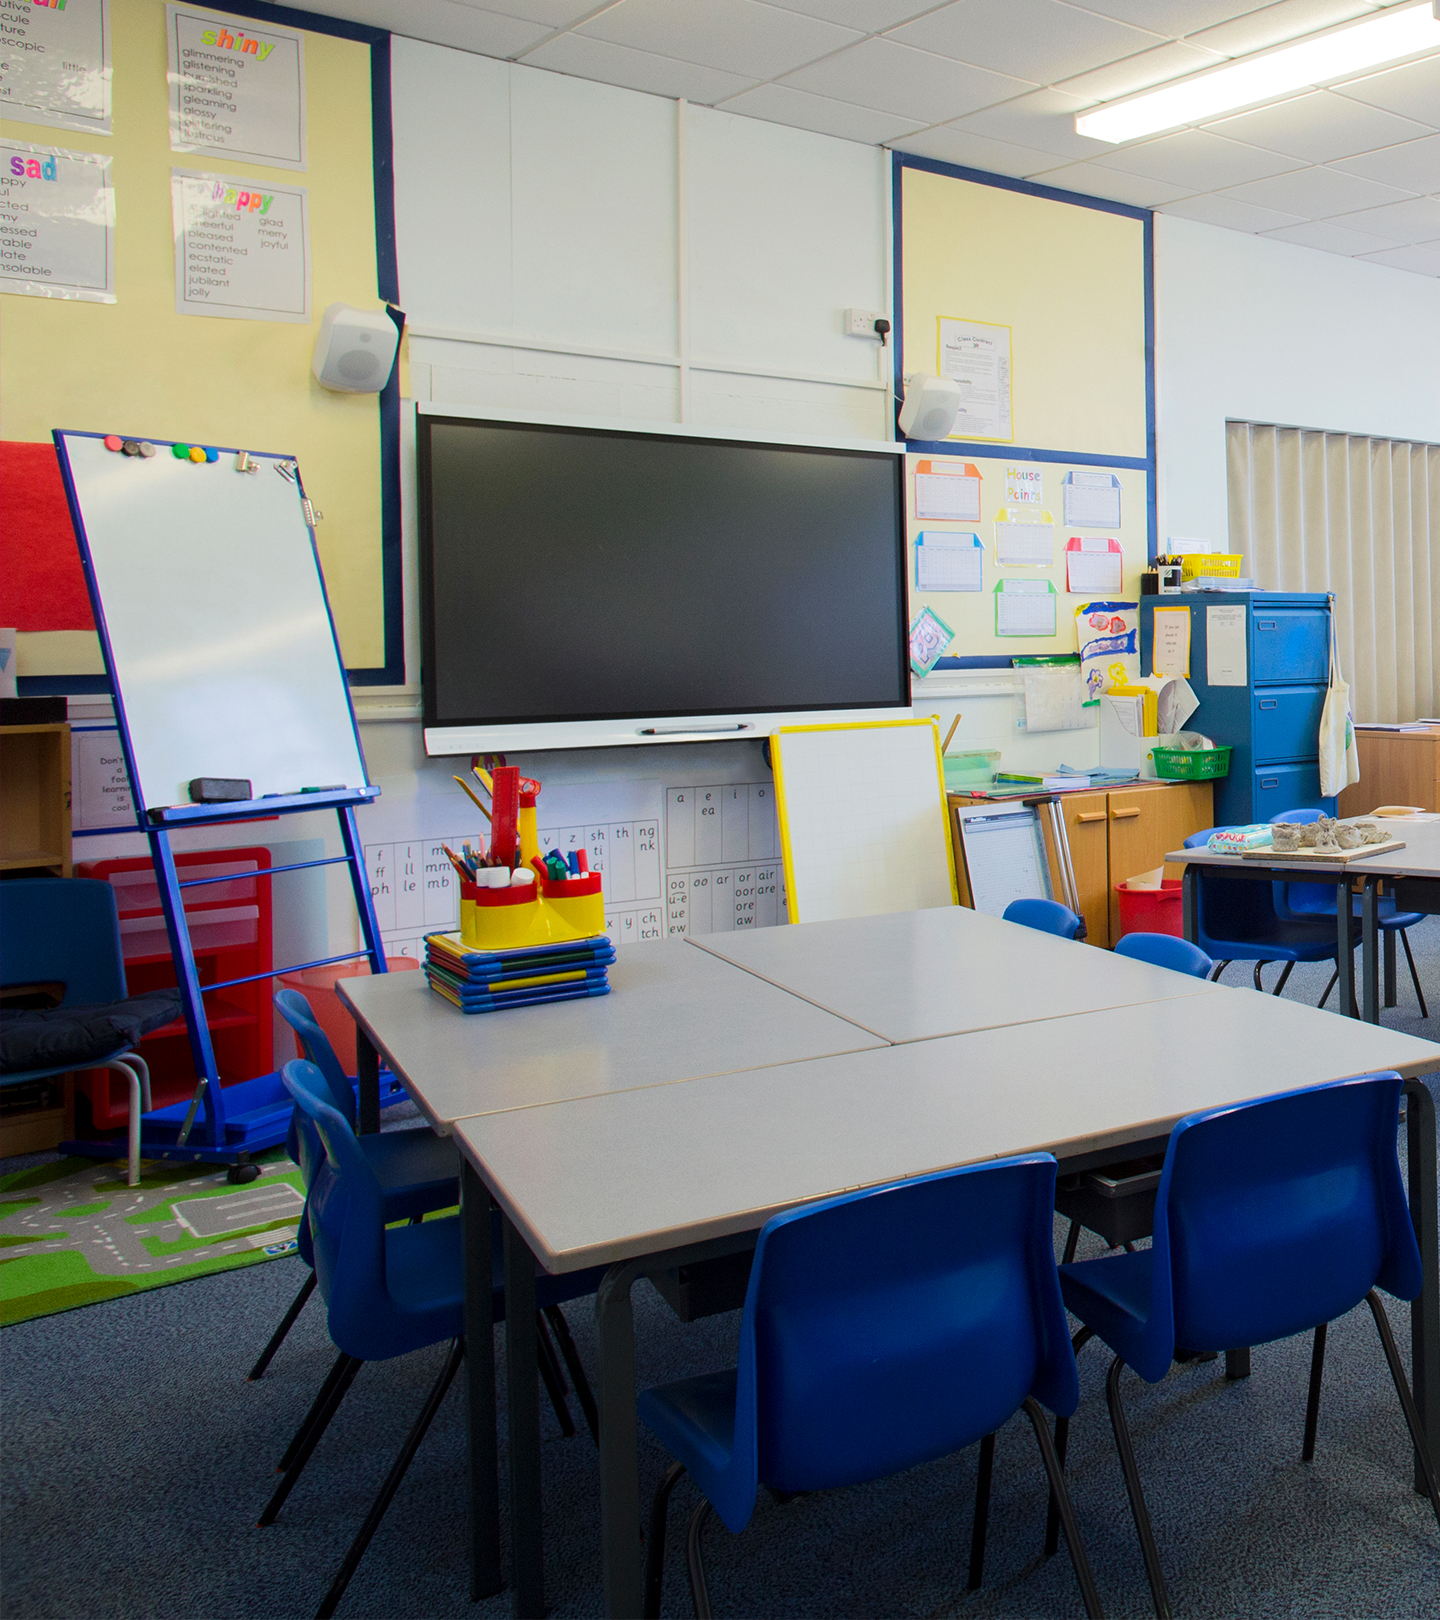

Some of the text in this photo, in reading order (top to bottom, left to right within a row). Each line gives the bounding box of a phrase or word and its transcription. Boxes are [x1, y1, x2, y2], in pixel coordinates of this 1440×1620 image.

[200, 28, 275, 61] shiny
[182, 48, 245, 69] glimmering
[182, 60, 236, 78] glistening
[183, 70, 238, 88] burished
[183, 83, 233, 100] sparkling
[183, 95, 237, 113] gleaming
[183, 107, 217, 120] glossy
[10, 154, 57, 181] sad
[212, 181, 275, 215] happy
[259, 218, 284, 228] glad
[188, 230, 234, 243] pleased
[258, 228, 288, 240] merry
[188, 241, 248, 256] contented
[260, 239, 289, 251] joyful
[188, 253, 234, 266] ecstatic
[188, 264, 227, 276] elated
[188, 275, 230, 288] jubilant
[188, 286, 210, 298] jolly
[1007, 467, 1041, 481] House
[1007, 487, 1041, 501] Points
[100, 757, 123, 765] Don't
[677, 794, 684, 803] a
[705, 792, 712, 801] e
[733, 789, 737, 799] i
[758, 789, 765, 798] o
[112, 803, 130, 812] cool
[701, 806, 715, 815] ea
[590, 829, 605, 841] sh
[616, 827, 629, 838] th
[639, 827, 655, 839] ng
[543, 837, 551, 845] v
[569, 834, 576, 843] z
[594, 846, 603, 856] ti
[640, 840, 655, 851] nk
[377, 850, 383, 861] f
[432, 847, 444, 856] m
[405, 863, 414, 875] ll
[425, 862, 451, 873] mm
[593, 860, 604, 871] ci
[375, 866, 385, 878] ff
[758, 869, 775, 881] air
[427, 876, 450, 889] mb
[693, 877, 708, 887] oo
[716, 875, 729, 885] ar
[738, 873, 751, 883] or
[371, 882, 390, 896] ph
[403, 880, 416, 891] le
[670, 880, 685, 890] oo
[757, 884, 776, 895] are
[735, 886, 755, 897] oor
[668, 894, 688, 905] u-e
[735, 901, 755, 912] ore
[642, 912, 657, 924] ch
[671, 909, 685, 919] ue
[606, 919, 614, 928] x
[625, 918, 633, 929] y
[736, 915, 754, 926] aw
[641, 926, 659, 939] tch
[669, 923, 687, 934] ew
[401, 947, 408, 956] c
